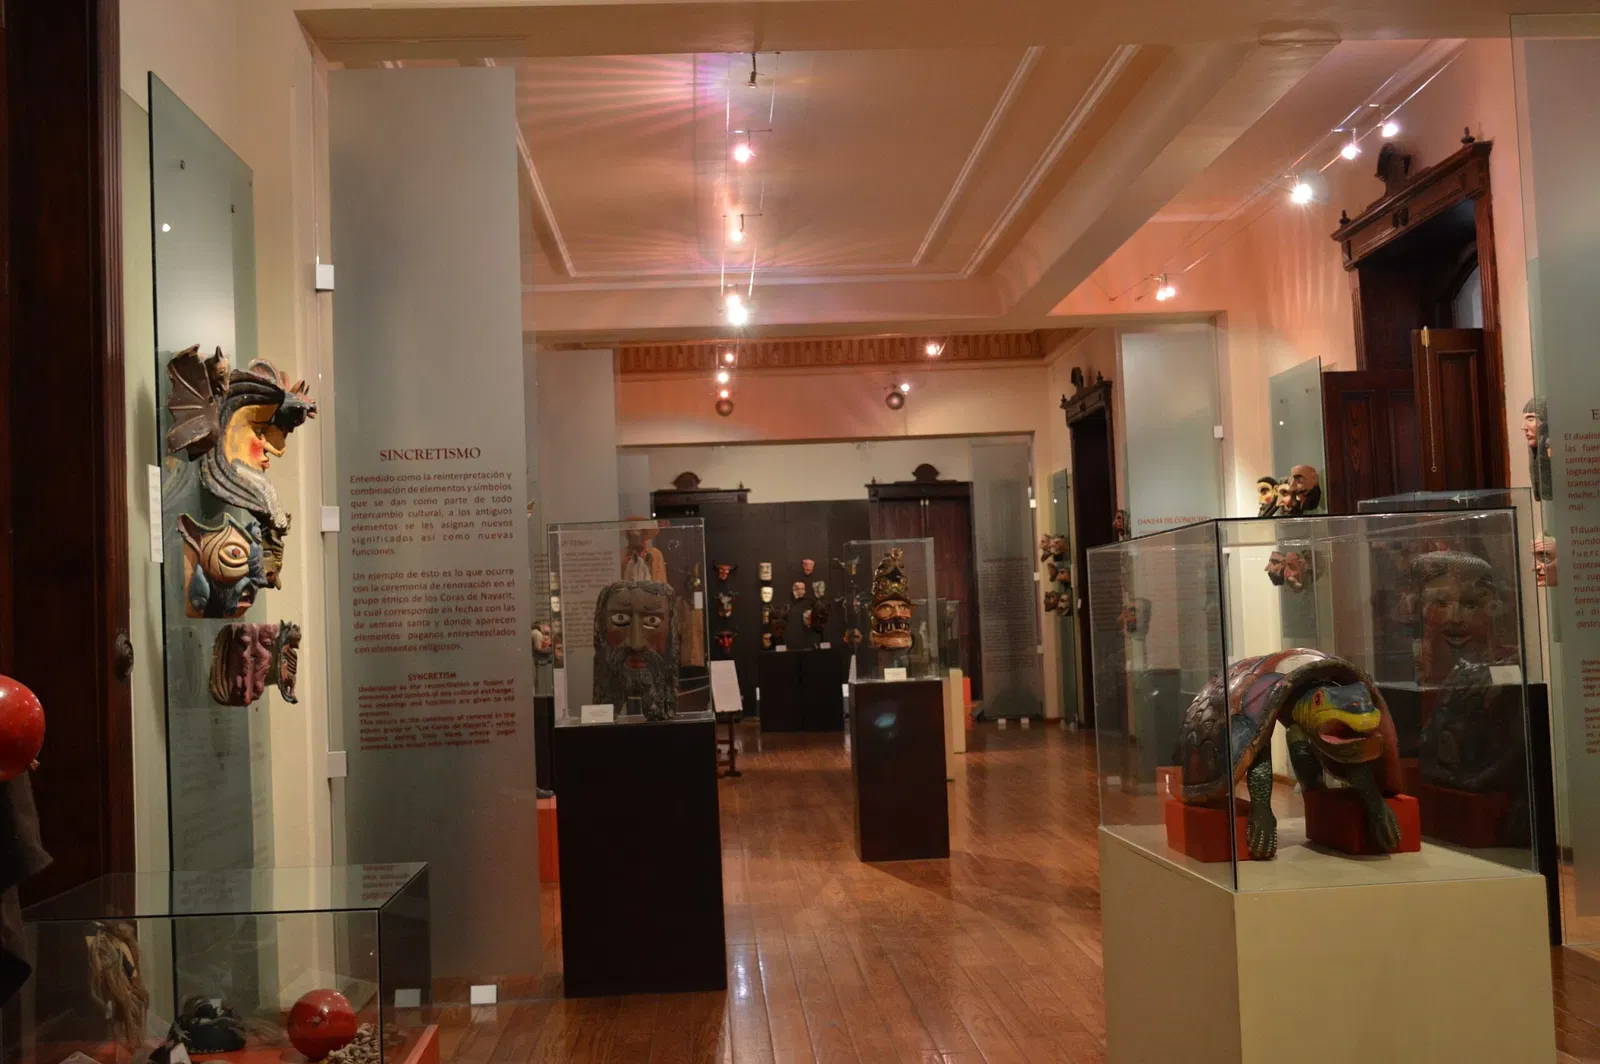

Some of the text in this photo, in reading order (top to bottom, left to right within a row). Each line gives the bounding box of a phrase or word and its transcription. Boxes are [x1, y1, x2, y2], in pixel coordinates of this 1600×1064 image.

[380, 447, 481, 461] SINCRETISMO
[1565, 444, 1576, 452] las
[350, 474, 394, 483] Entendido
[423, 473, 431, 481] la
[433, 471, 504, 482] reinterpretación
[350, 483, 512, 496] combinación de elementos y símbolos
[351, 500, 367, 508] que
[390, 497, 406, 506] dan
[444, 497, 467, 506] parte
[351, 510, 403, 520] intercambio
[458, 508, 470, 516] los
[476, 508, 512, 517] antiguos
[352, 523, 397, 532] elementos
[422, 521, 433, 529] les
[441, 521, 474, 531] asignan
[352, 535, 413, 546] significados
[421, 533, 435, 542] así
[352, 547, 396, 556] funciones.
[368, 571, 403, 582] ejemplo
[466, 569, 482, 578] que
[371, 583, 378, 592] la
[381, 582, 427, 591] ceremonia
[443, 580, 490, 589] renovación
[507, 579, 514, 587] el
[353, 597, 378, 606] grupo
[412, 594, 422, 602] de
[425, 594, 437, 602] los
[440, 593, 464, 602] Coras
[467, 592, 477, 600] de
[354, 608, 361, 617] la
[363, 608, 381, 617] cual
[384, 605, 439, 615] corresponde
[455, 604, 483, 613] fechas
[503, 603, 515, 612] las
[354, 621, 364, 629] de
[369, 620, 402, 628] semana
[407, 618, 430, 628] santa
[444, 617, 471, 626] donde
[476, 616, 516, 626] aparecen
[354, 628, 516, 642] elementos paganos entremezclados
[354, 646, 370, 654] con
[371, 644, 418, 653] elementos
[408, 672, 456, 681] SYNCRETISM
